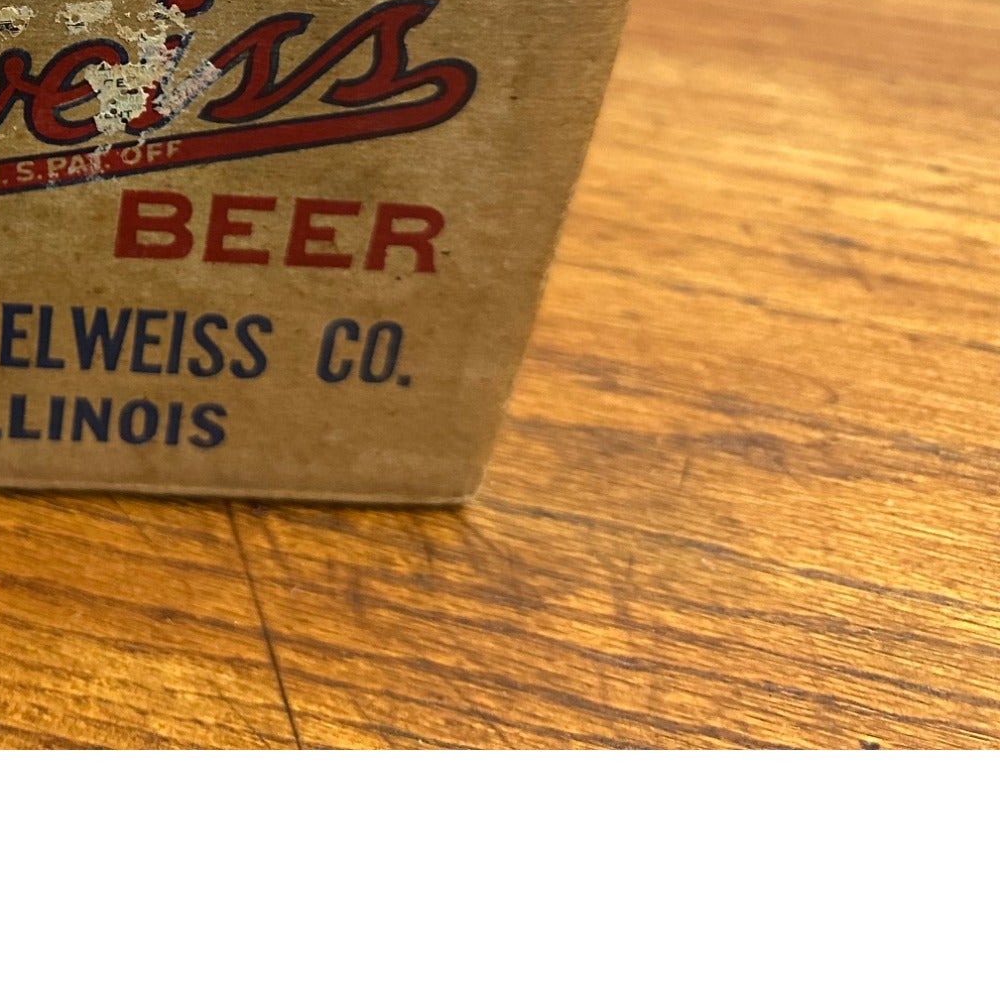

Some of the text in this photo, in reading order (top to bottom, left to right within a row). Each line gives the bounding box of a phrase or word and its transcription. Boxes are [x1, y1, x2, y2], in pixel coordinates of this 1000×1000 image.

[120, 139, 184, 166] OFF
[114, 189, 446, 274] BEER
[315, 317, 412, 388] CO.
